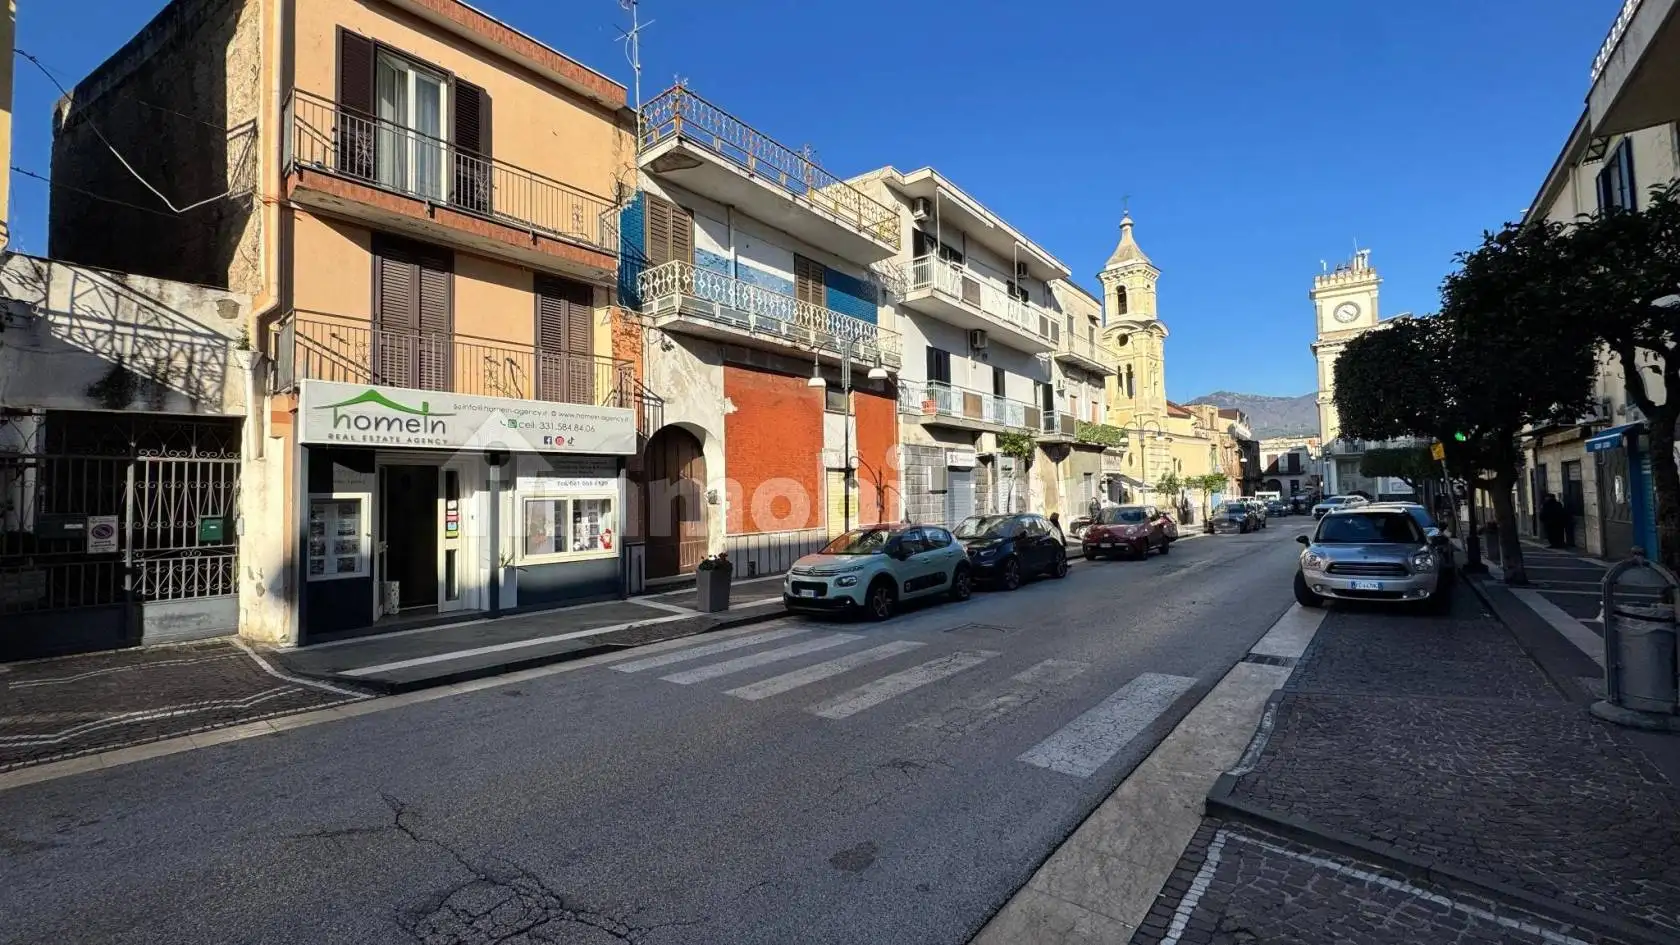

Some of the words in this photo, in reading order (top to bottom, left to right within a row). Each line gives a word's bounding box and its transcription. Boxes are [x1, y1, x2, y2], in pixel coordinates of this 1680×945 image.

[328, 433, 356, 441] REAL
[362, 434, 400, 443] ESTATE
[406, 437, 448, 445] AGENCY
